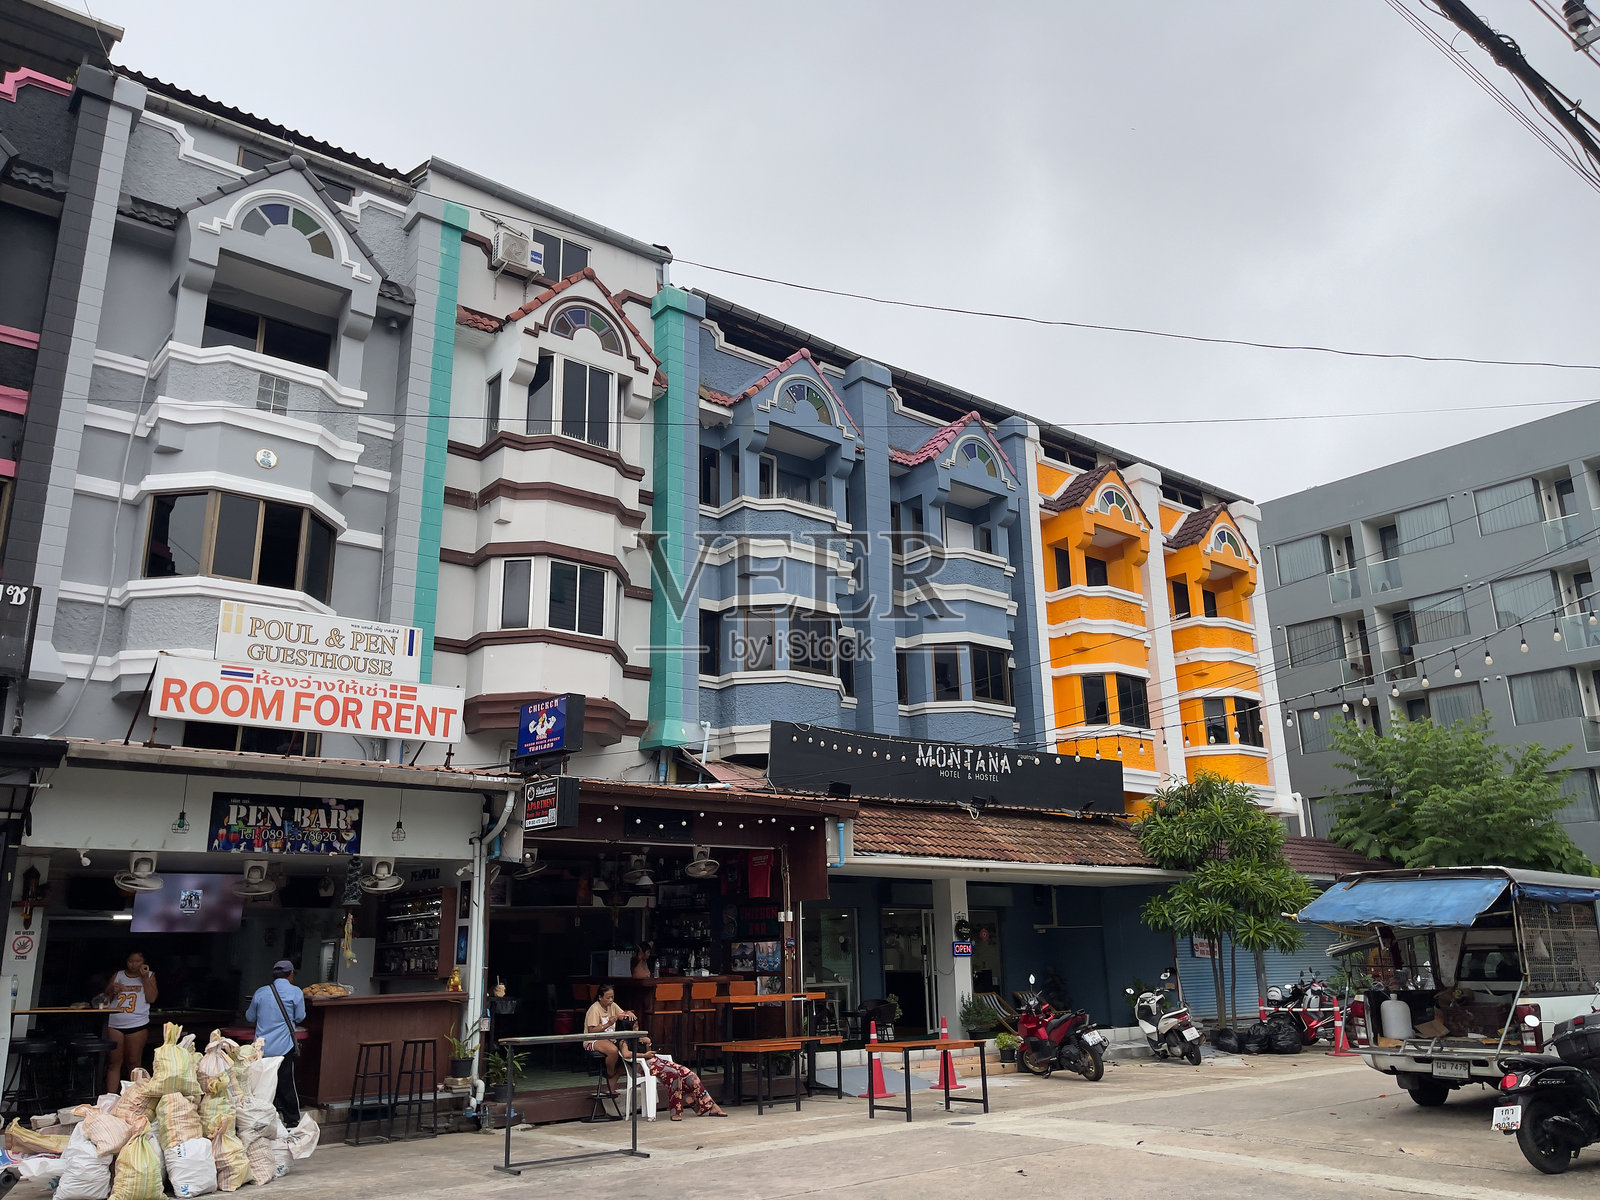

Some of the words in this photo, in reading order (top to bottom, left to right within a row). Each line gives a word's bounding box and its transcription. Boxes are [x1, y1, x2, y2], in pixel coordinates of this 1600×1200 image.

[247, 616, 319, 645] POUL
[325, 627, 345, 649] &
[350, 631, 398, 656] PEN
[247, 643, 393, 677] GUESTHOUSE
[255, 669, 389, 699] ห้องว่างให้เช่า
[159, 677, 283, 722] ROOM
[292, 693, 363, 729] FOR
[370, 699, 457, 738] RENT
[528, 699, 559, 714] CHICKEN
[528, 742, 554, 753] THAILAND
[917, 744, 1011, 774] MONTANA
[940, 770, 960, 779] HOTEL
[967, 772, 972, 780] &
[975, 773, 999, 783] HOSTEL
[527, 797, 556, 812] APARTMENT
[227, 804, 285, 827] PEN
[294, 807, 351, 830] BAR
[955, 944, 972, 953] OPEN
[116, 993, 137, 1013] 23
